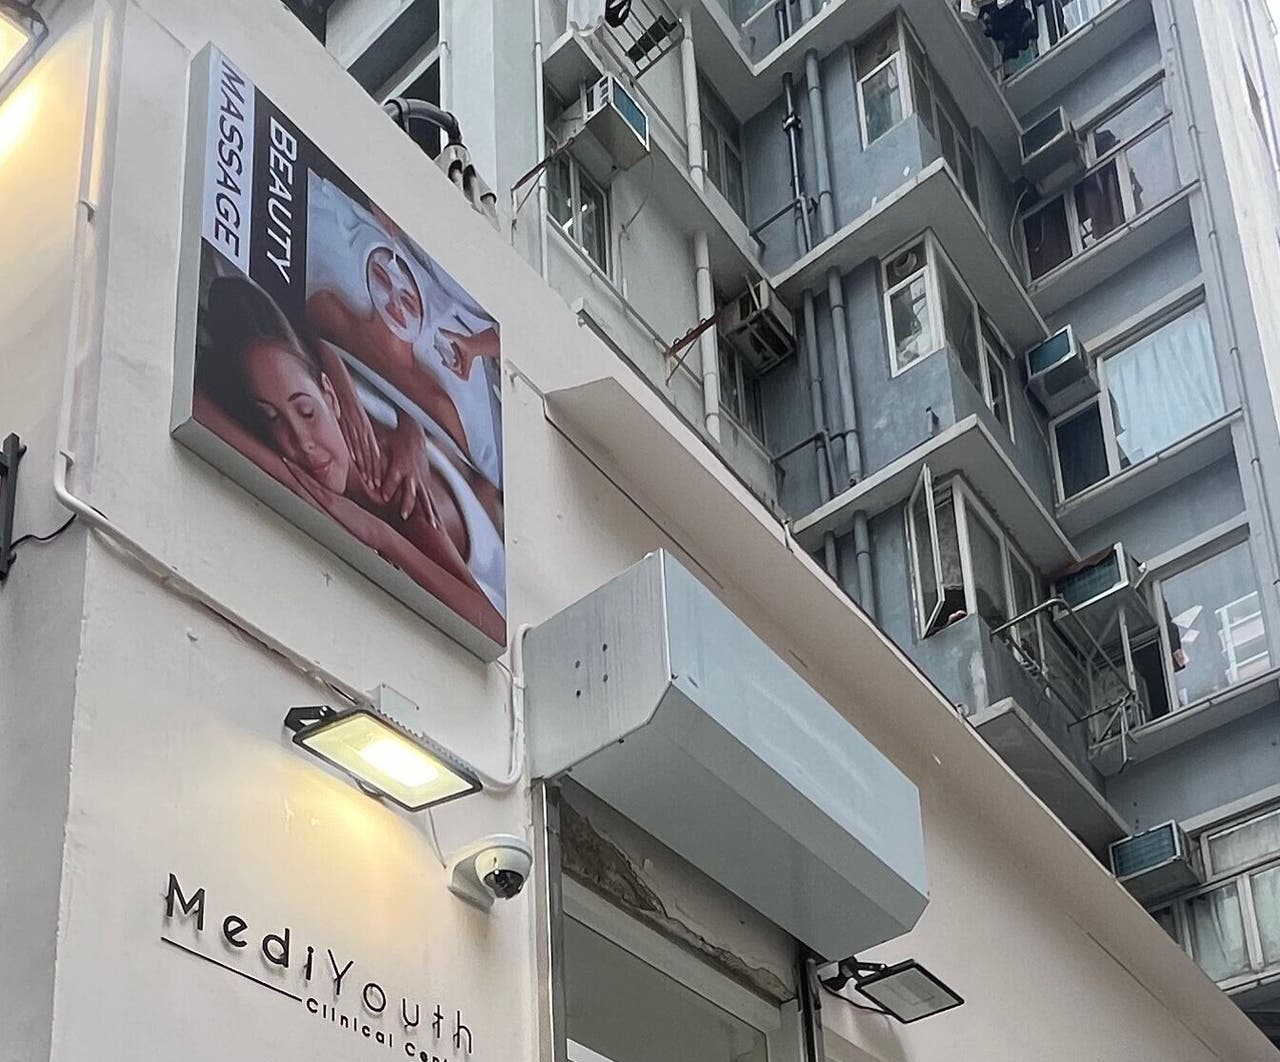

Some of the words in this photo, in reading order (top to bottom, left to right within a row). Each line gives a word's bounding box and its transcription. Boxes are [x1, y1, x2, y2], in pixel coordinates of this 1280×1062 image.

[214, 59, 246, 258] MASSAGE
[266, 115, 298, 283] BEAUTY
[165, 872, 473, 1054] MediYouth
[306, 997, 393, 1047] Clinical
